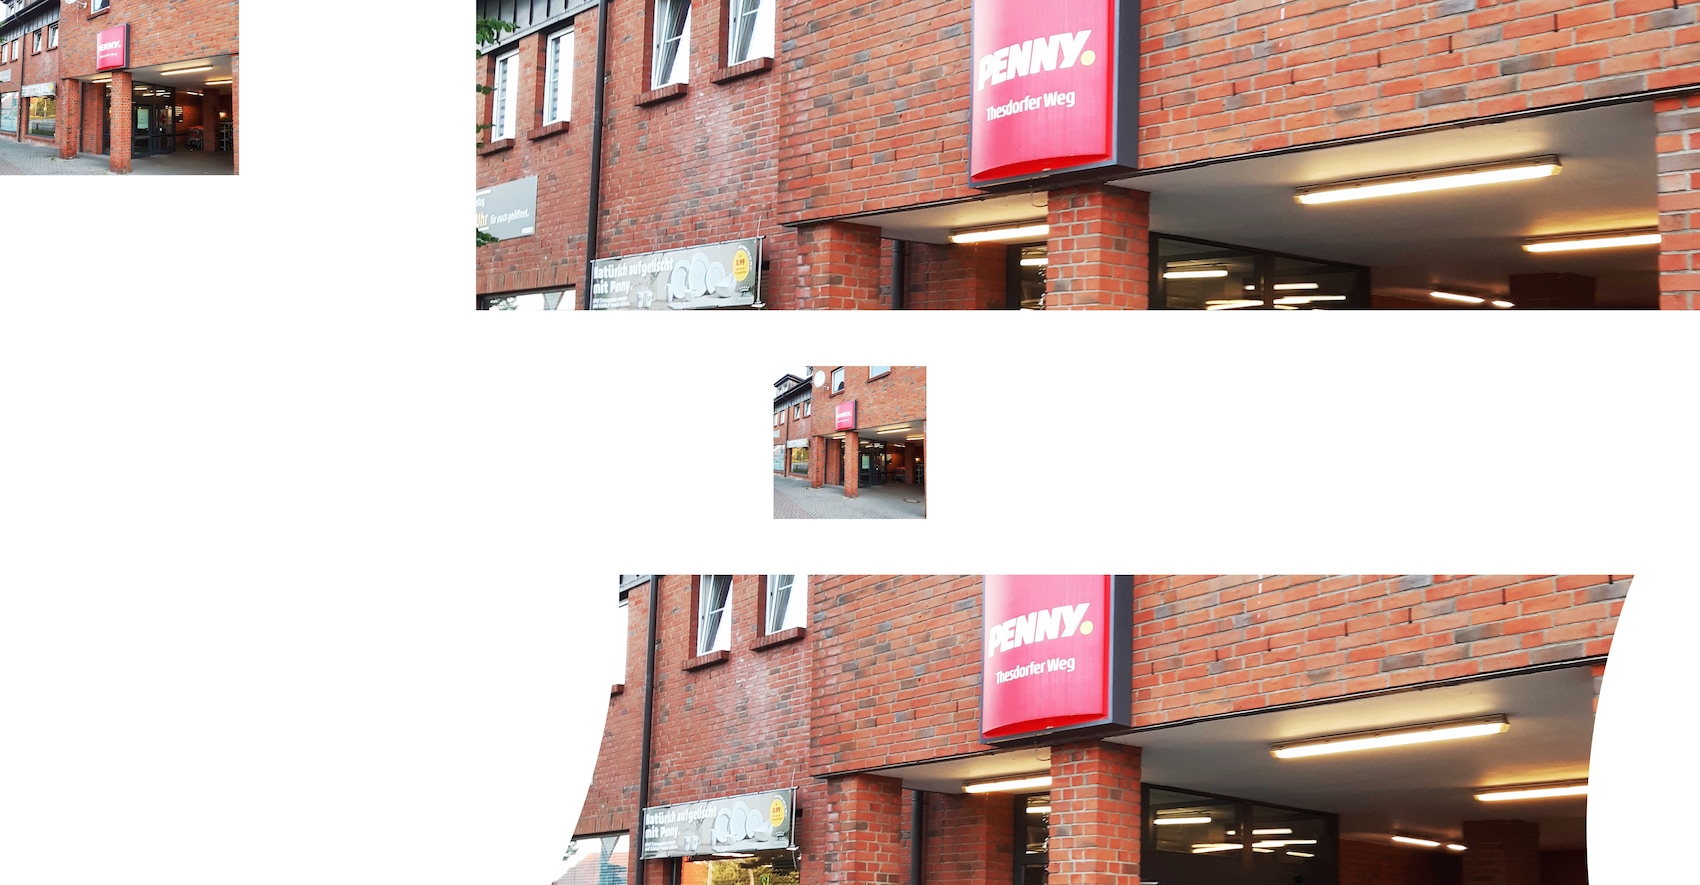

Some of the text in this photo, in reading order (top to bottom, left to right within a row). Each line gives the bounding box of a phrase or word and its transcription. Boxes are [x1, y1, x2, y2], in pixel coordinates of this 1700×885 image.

[977, 29, 1096, 92] PENNY.
[986, 91, 1075, 121] Thesdorfer Weg
[593, 279, 608, 294] mit
[988, 602, 1094, 658] PENNY.
[995, 657, 1075, 684] Thesdorfer Weg
[645, 825, 659, 838] mit
